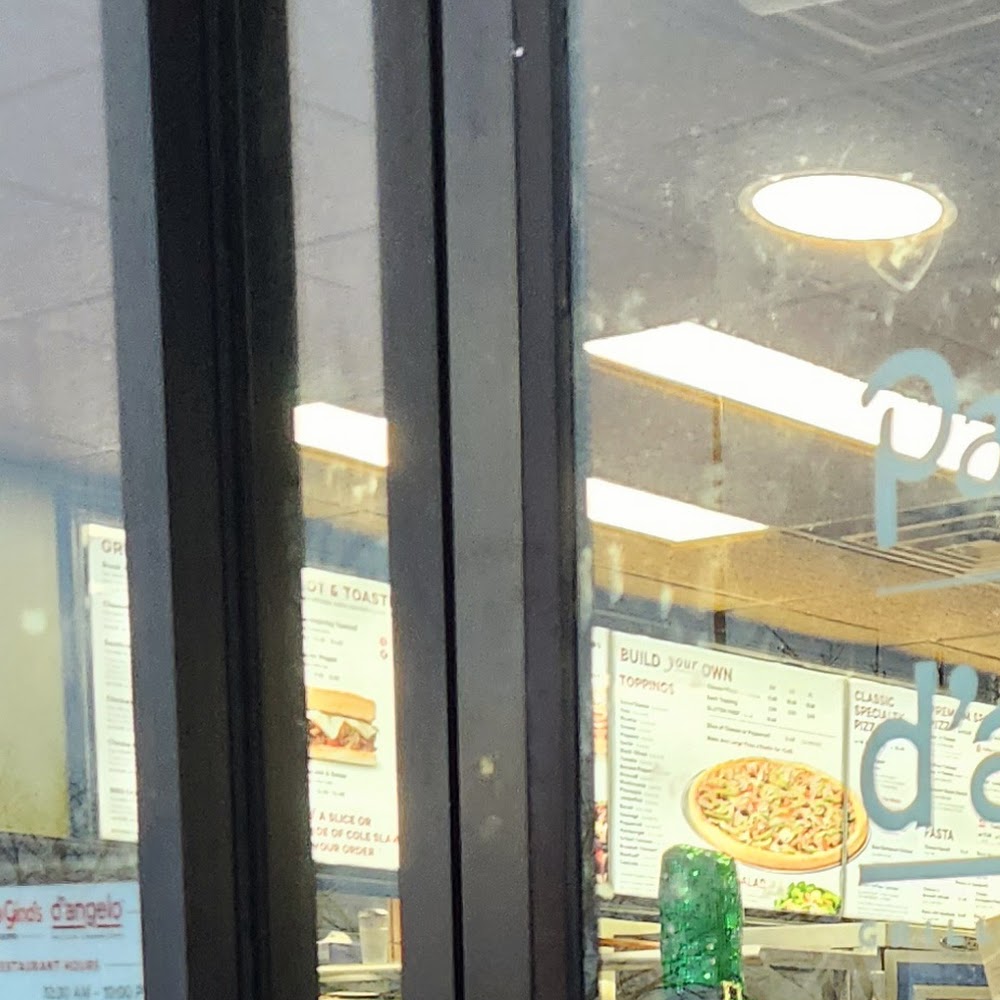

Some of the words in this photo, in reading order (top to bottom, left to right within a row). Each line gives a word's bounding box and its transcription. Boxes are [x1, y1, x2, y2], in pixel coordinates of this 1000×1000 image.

[620, 648, 660, 668] BUILD
[664, 656, 698, 672] your
[702, 663, 733, 682] OWN
[619, 674, 675, 696] TOPPINGS
[854, 690, 895, 708] CLASSIC
[924, 827, 954, 842] PASTA
[73, 986, 91, 999] AM
